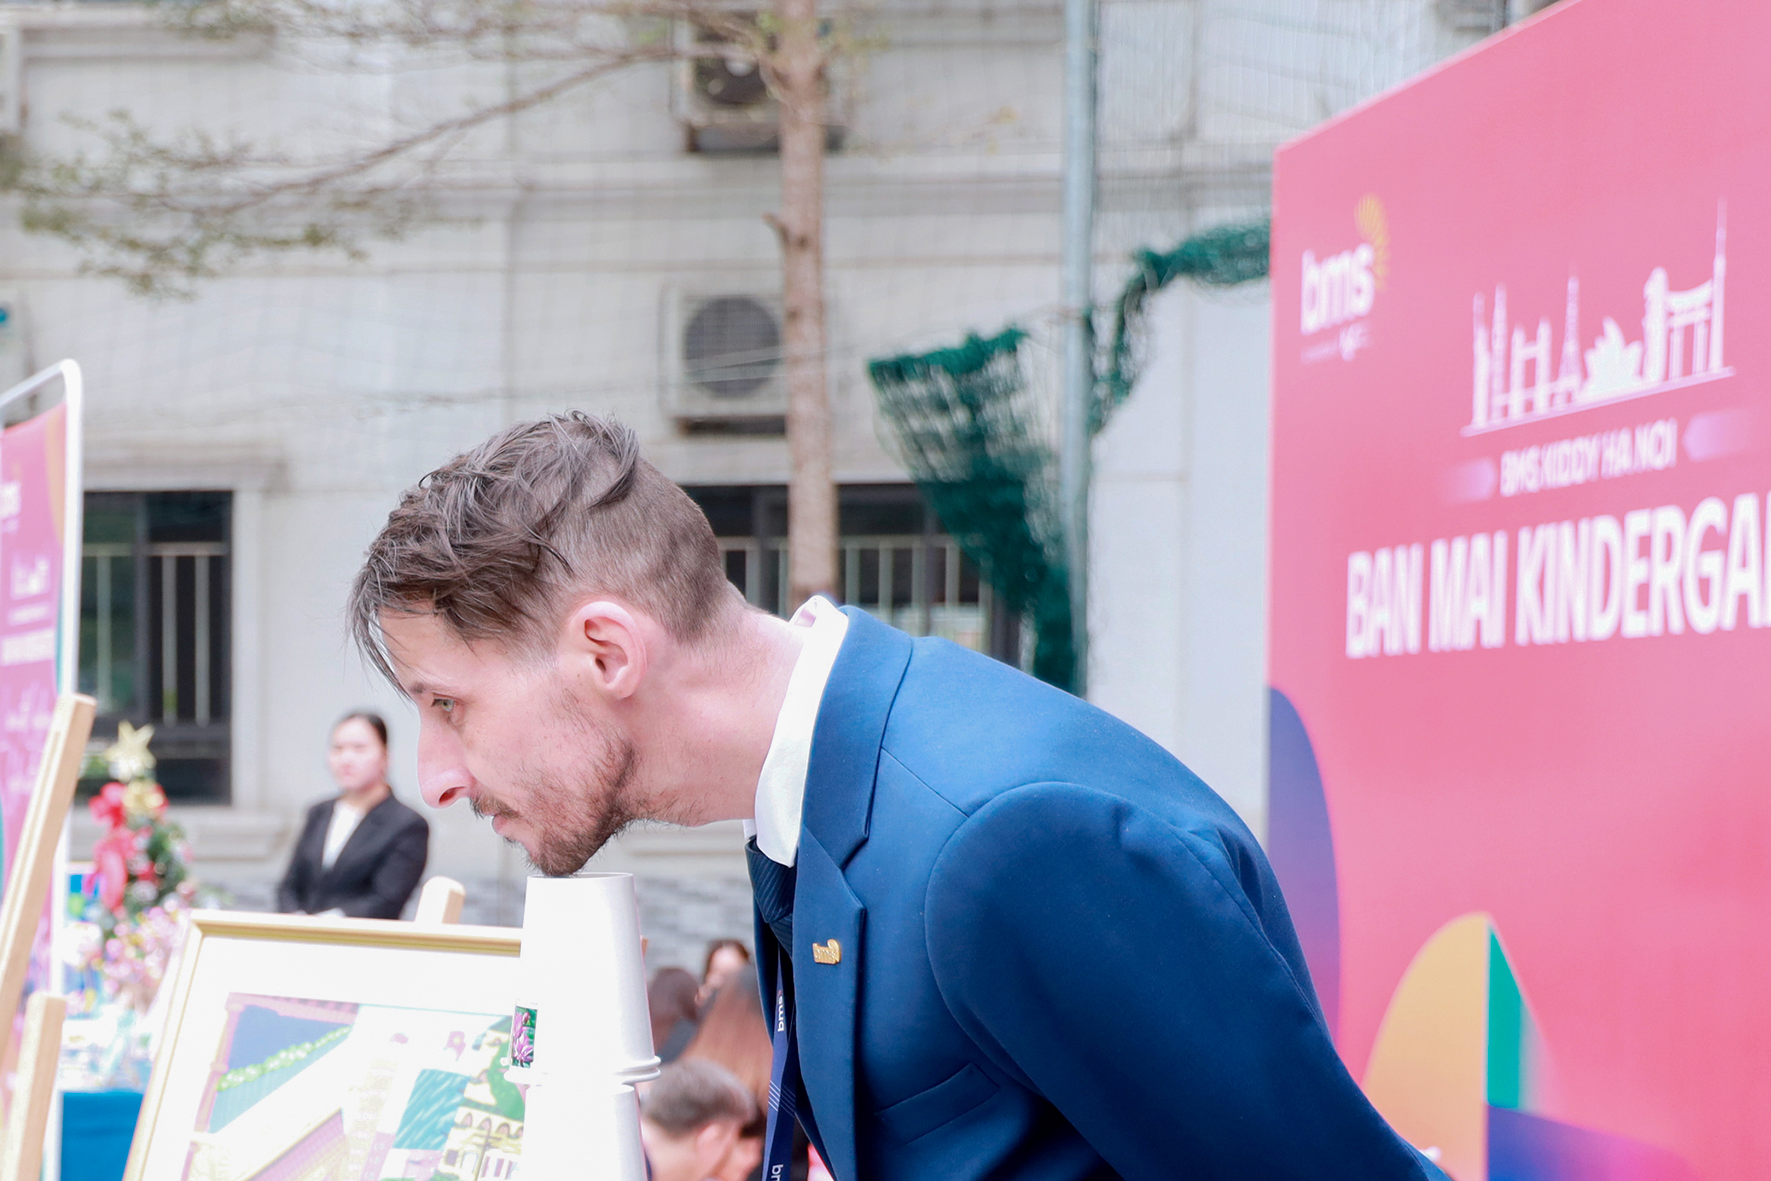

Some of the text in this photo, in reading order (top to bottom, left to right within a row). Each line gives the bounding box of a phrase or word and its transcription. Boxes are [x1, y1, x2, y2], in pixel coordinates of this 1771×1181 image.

[1301, 243, 1377, 335] bms
[1501, 444, 1540, 497] BMS
[1540, 430, 1600, 489] KIDDY
[1346, 542, 1424, 660] BAN
[1429, 529, 1509, 653] MAI
